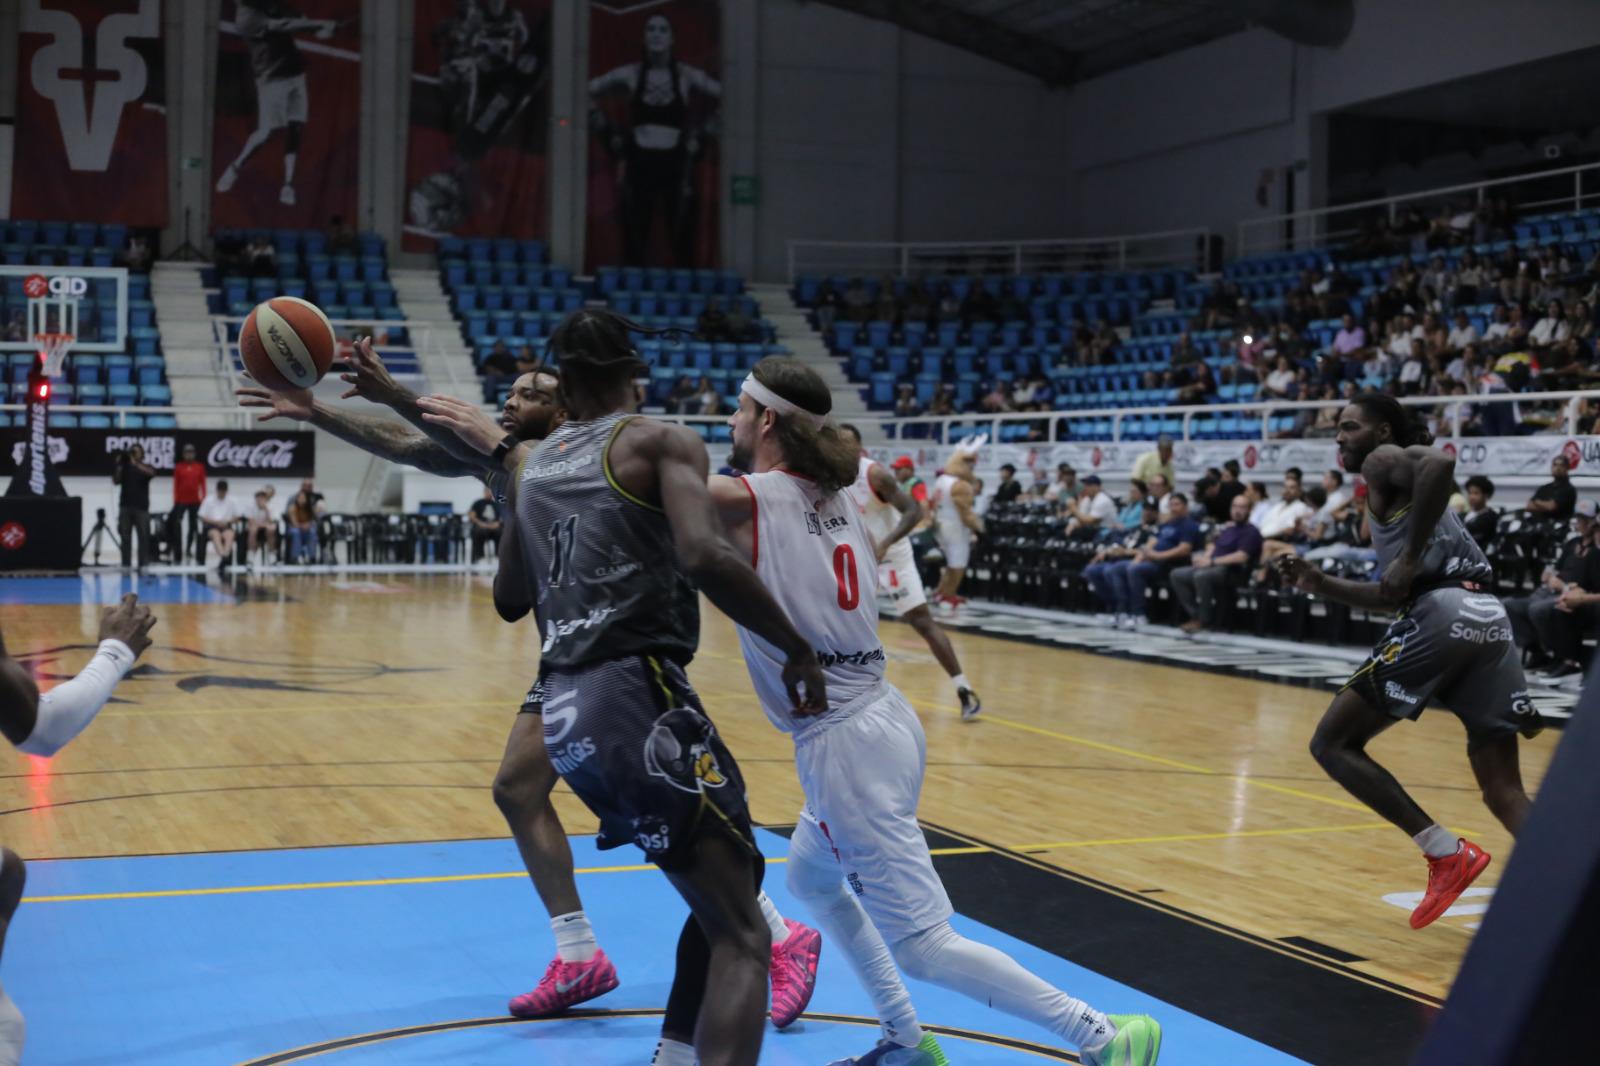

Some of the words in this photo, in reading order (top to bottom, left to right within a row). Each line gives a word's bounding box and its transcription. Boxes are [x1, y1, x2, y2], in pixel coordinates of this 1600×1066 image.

[29, 402, 47, 496] dportenis
[1459, 444, 1487, 464] CID
[548, 513, 580, 588] 11
[832, 543, 860, 611] 0
[1450, 622, 1513, 644] SoniGas
